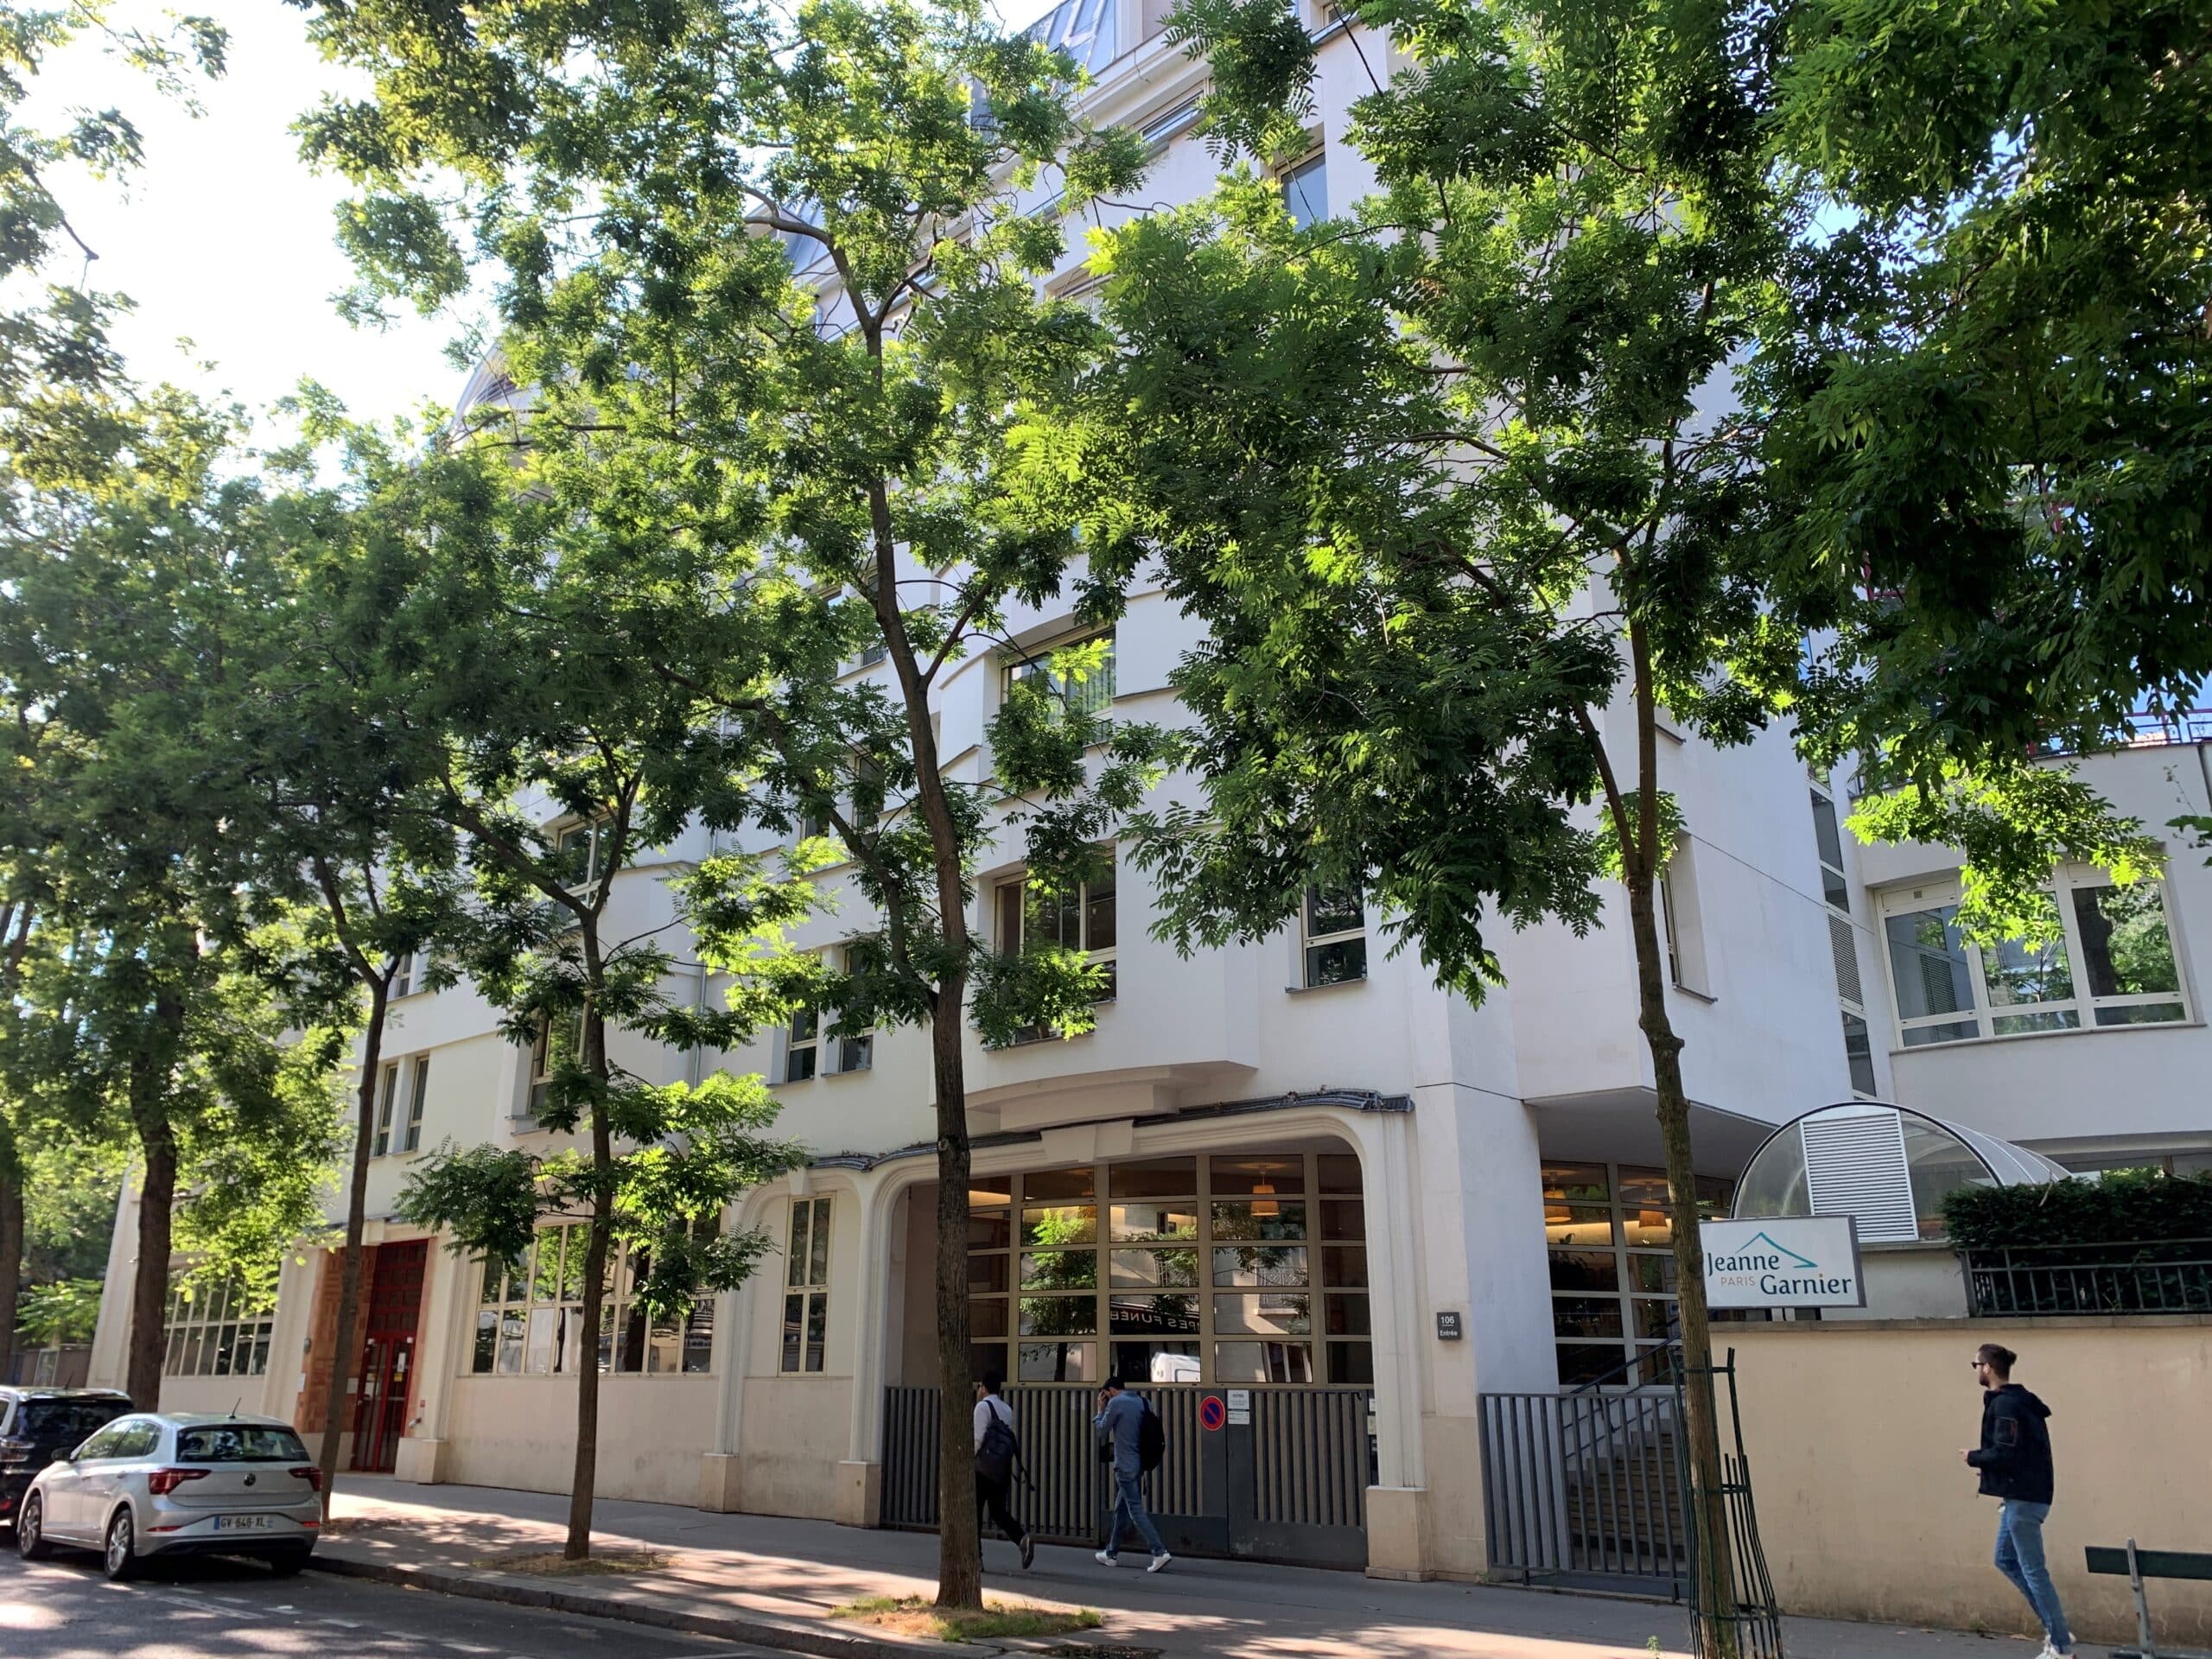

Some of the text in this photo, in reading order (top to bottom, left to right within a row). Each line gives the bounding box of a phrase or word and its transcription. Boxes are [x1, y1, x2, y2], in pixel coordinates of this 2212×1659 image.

[1707, 1253, 1780, 1276] Jeanne
[1720, 1276, 1756, 1287] PARIS
[1760, 1273, 1852, 1295] Garnier
[1441, 1316, 1455, 1325] 106
